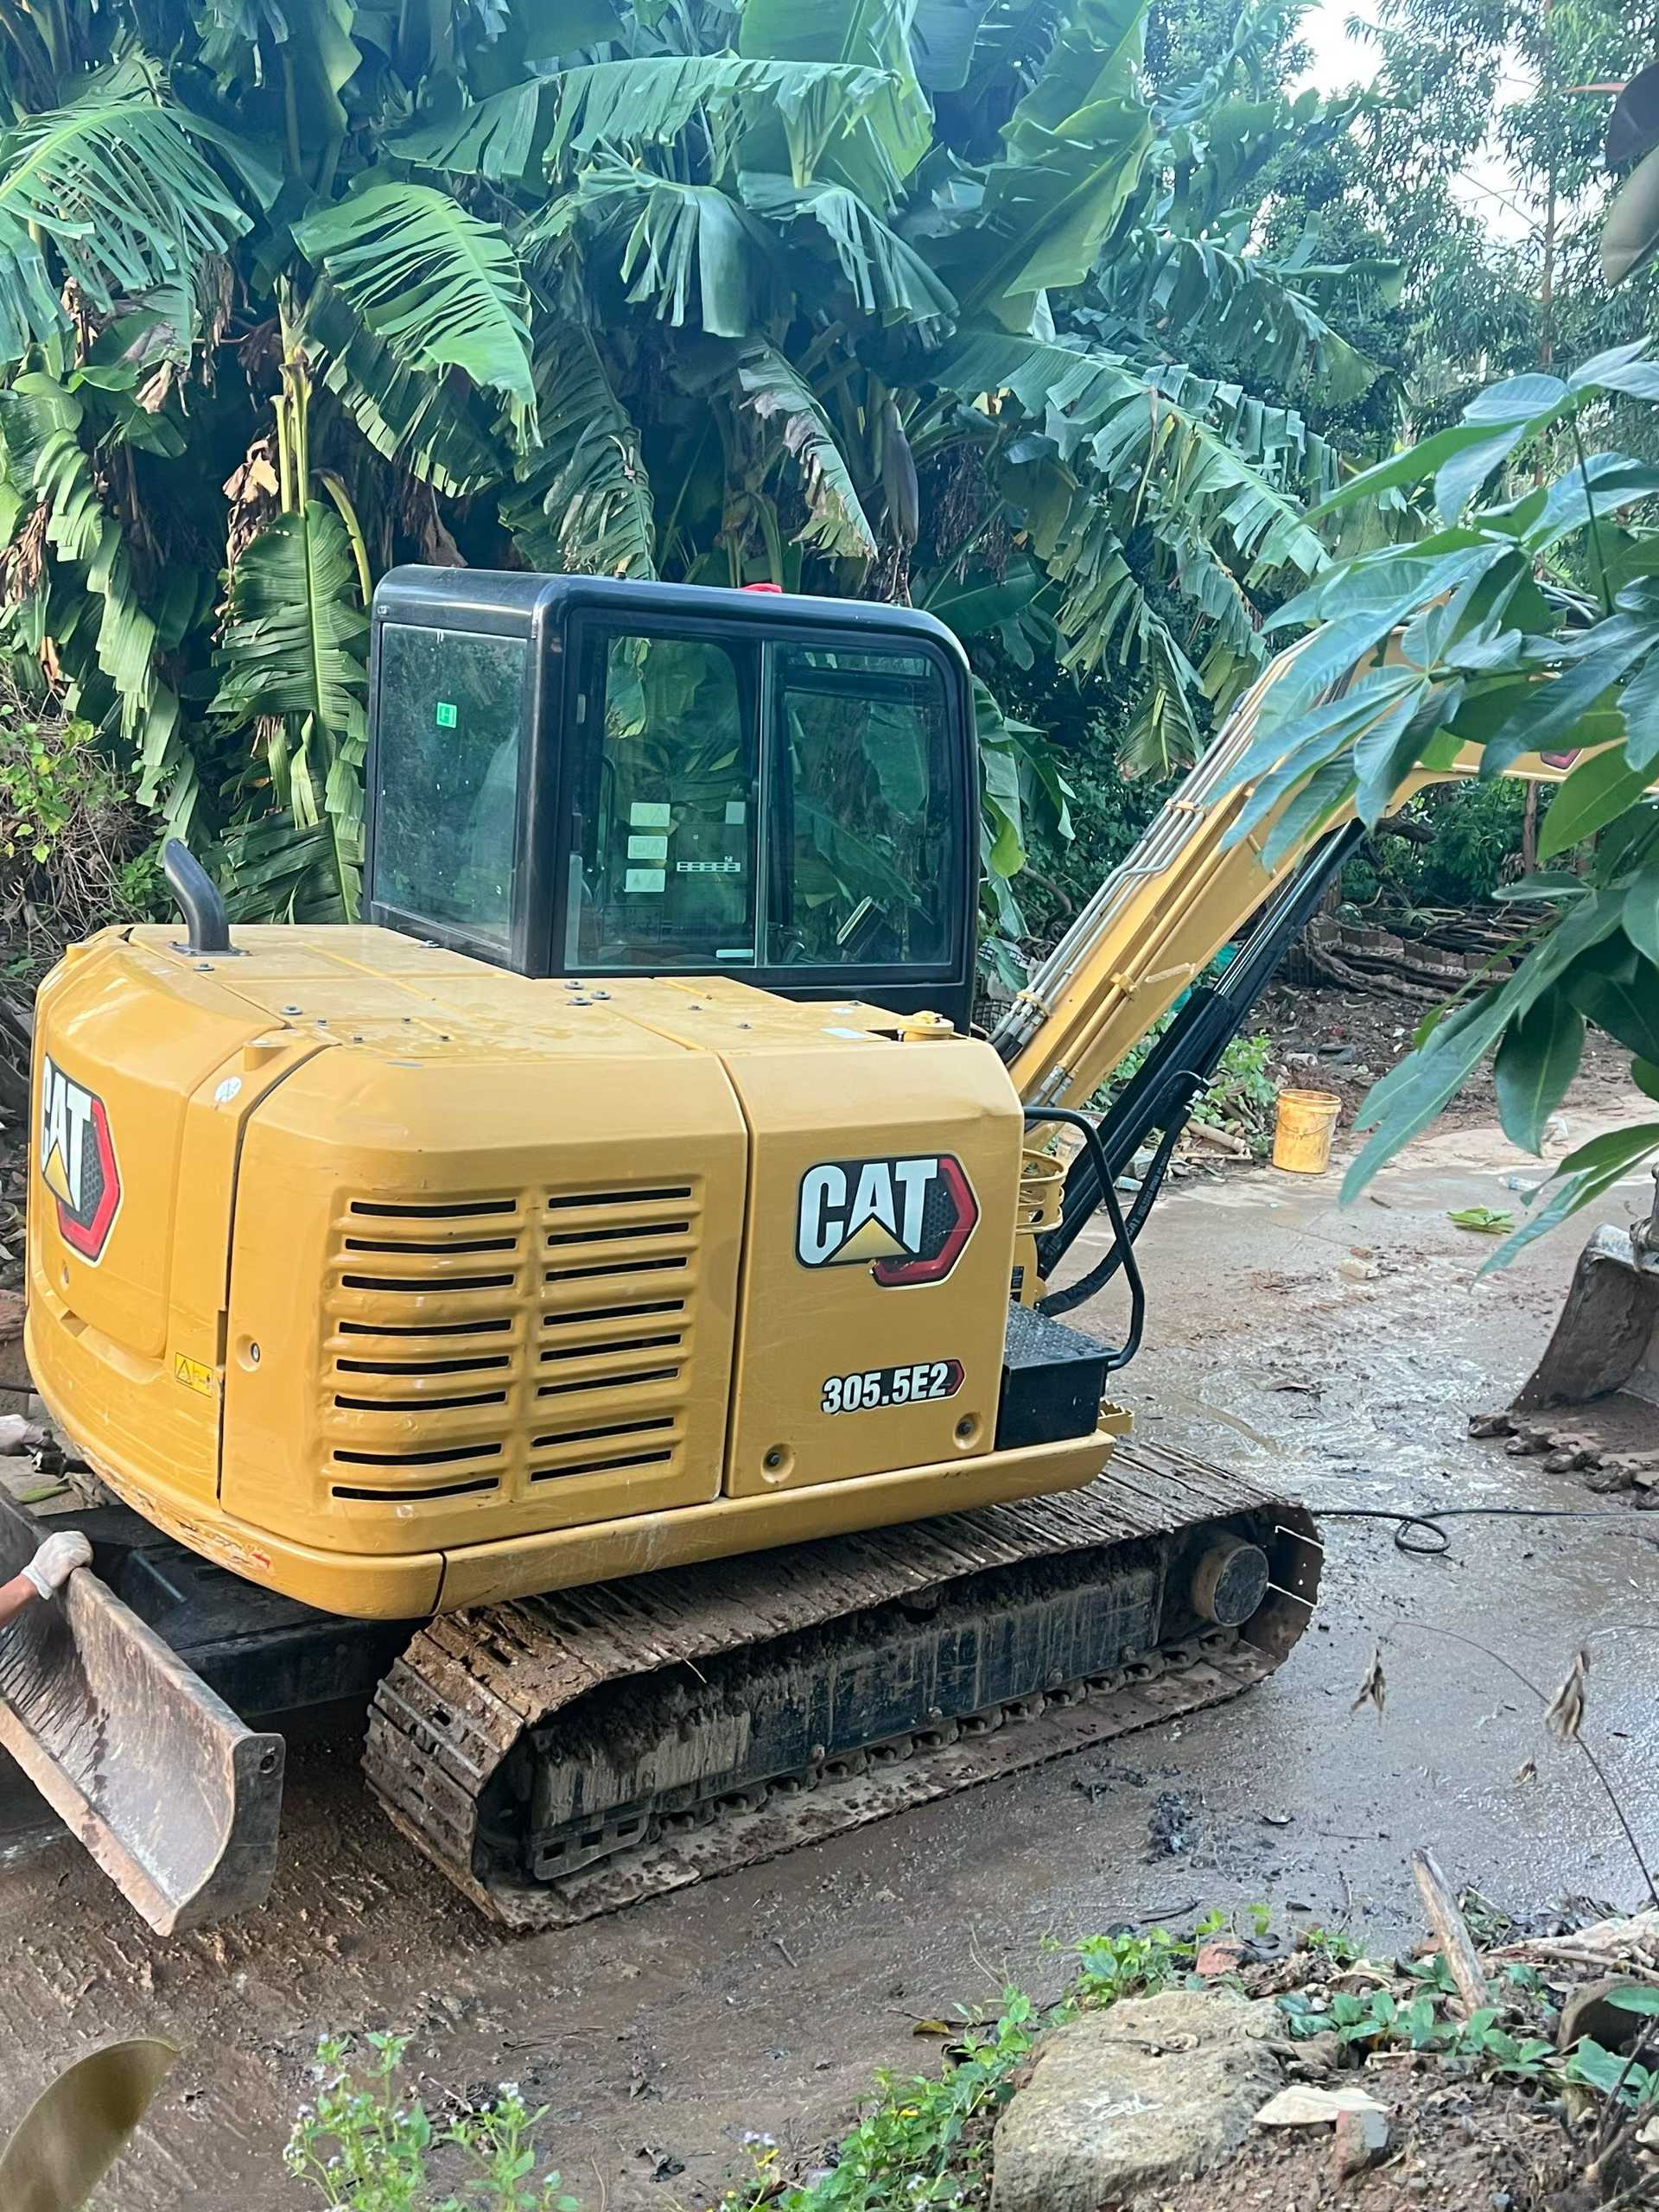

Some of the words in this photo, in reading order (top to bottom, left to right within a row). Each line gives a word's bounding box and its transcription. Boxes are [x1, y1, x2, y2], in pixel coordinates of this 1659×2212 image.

[41, 1055, 92, 1211] CAT
[799, 1159, 938, 1265] CAT
[822, 1362, 949, 1414] 305.5E2
